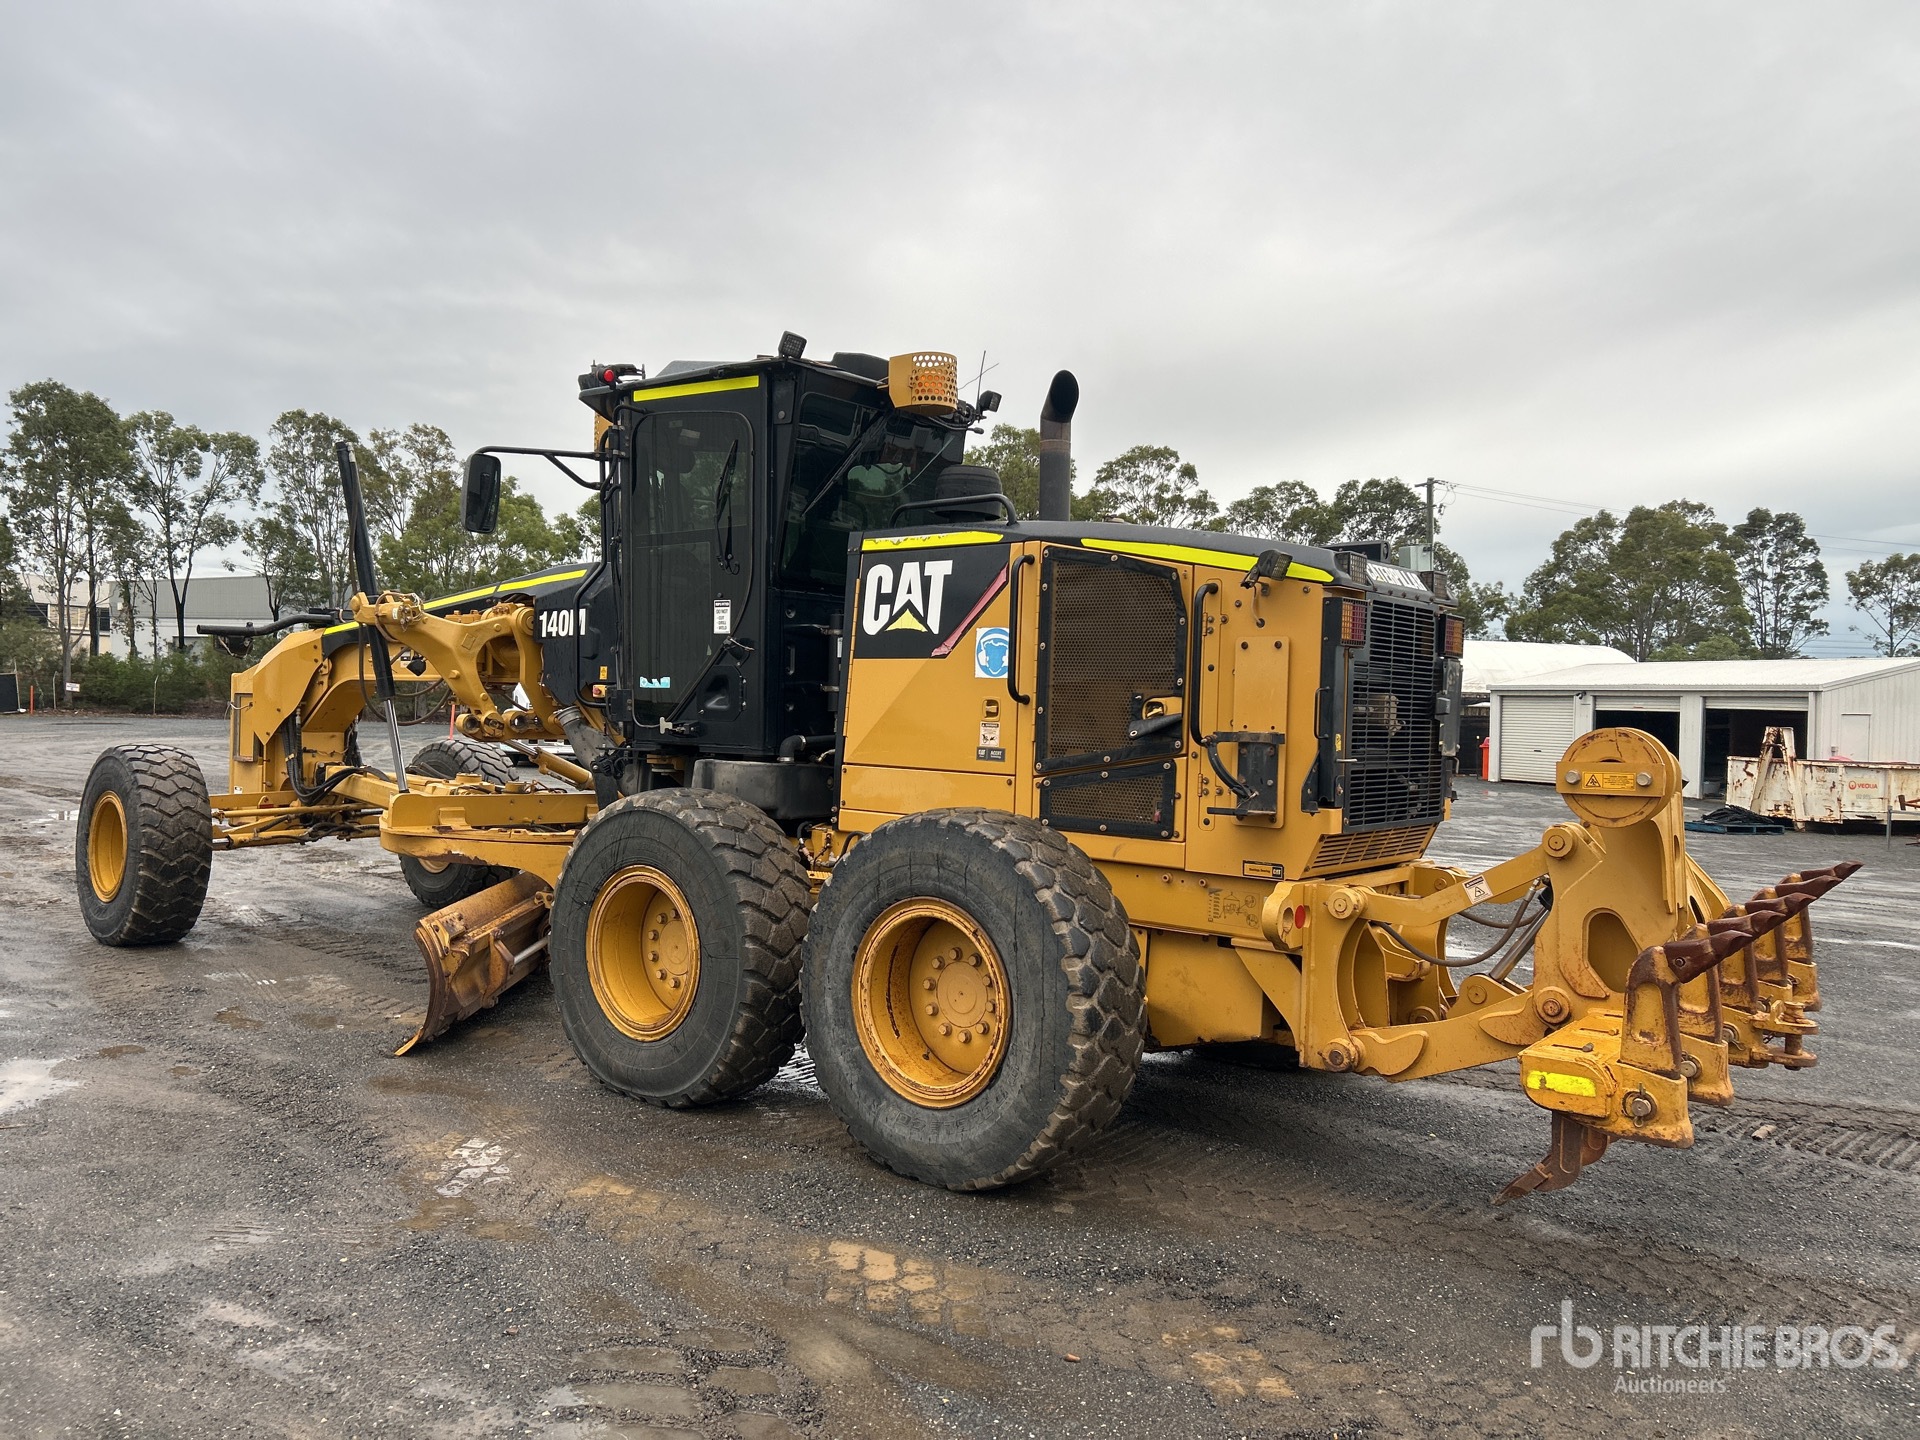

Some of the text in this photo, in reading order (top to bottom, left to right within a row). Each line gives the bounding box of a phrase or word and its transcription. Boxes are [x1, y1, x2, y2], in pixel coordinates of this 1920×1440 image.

[1366, 562, 1428, 592] CATERPILLAR
[863, 560, 953, 635] CAT
[539, 608, 586, 638] 140M
